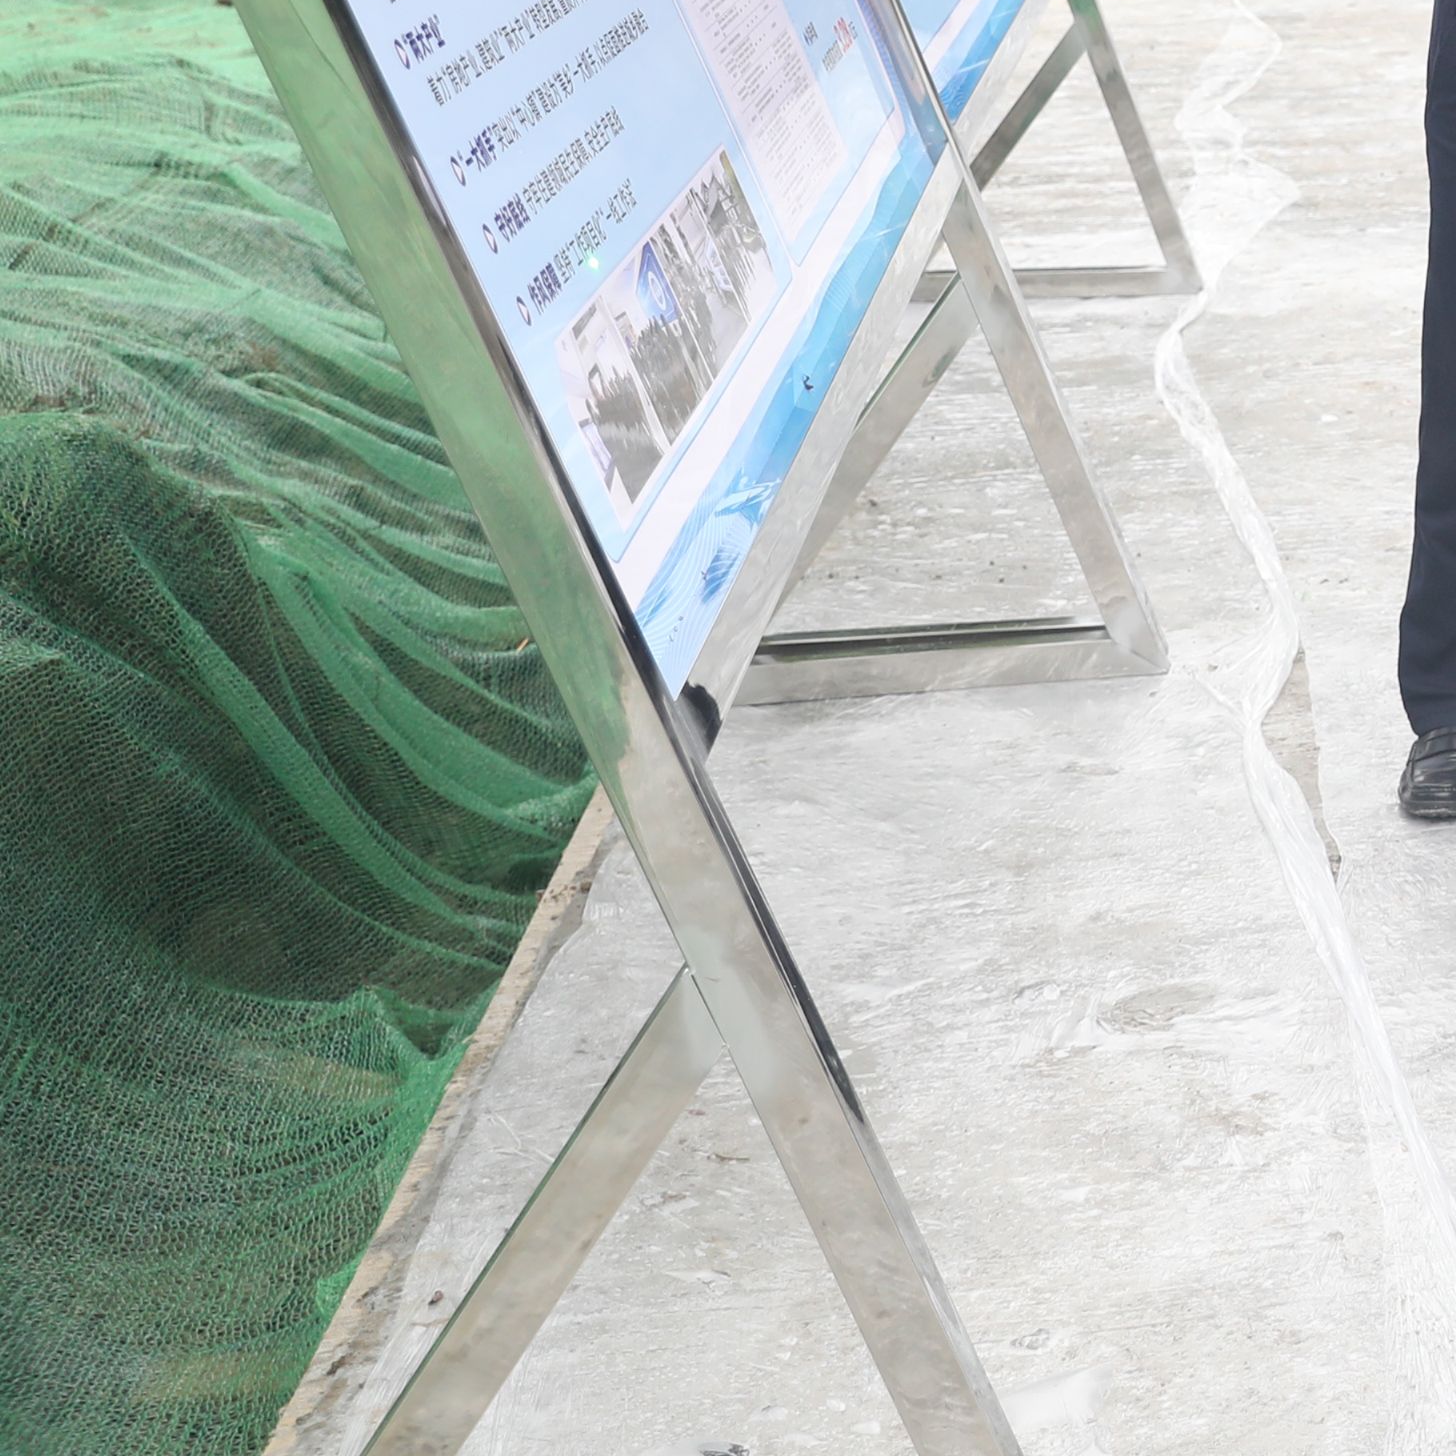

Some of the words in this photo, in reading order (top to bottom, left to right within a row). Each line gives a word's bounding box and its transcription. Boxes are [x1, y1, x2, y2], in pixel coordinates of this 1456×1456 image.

[400, 13, 450, 67] “两大产业”
[492, 191, 532, 247] 守好底线
[525, 260, 564, 316] 作风保障
